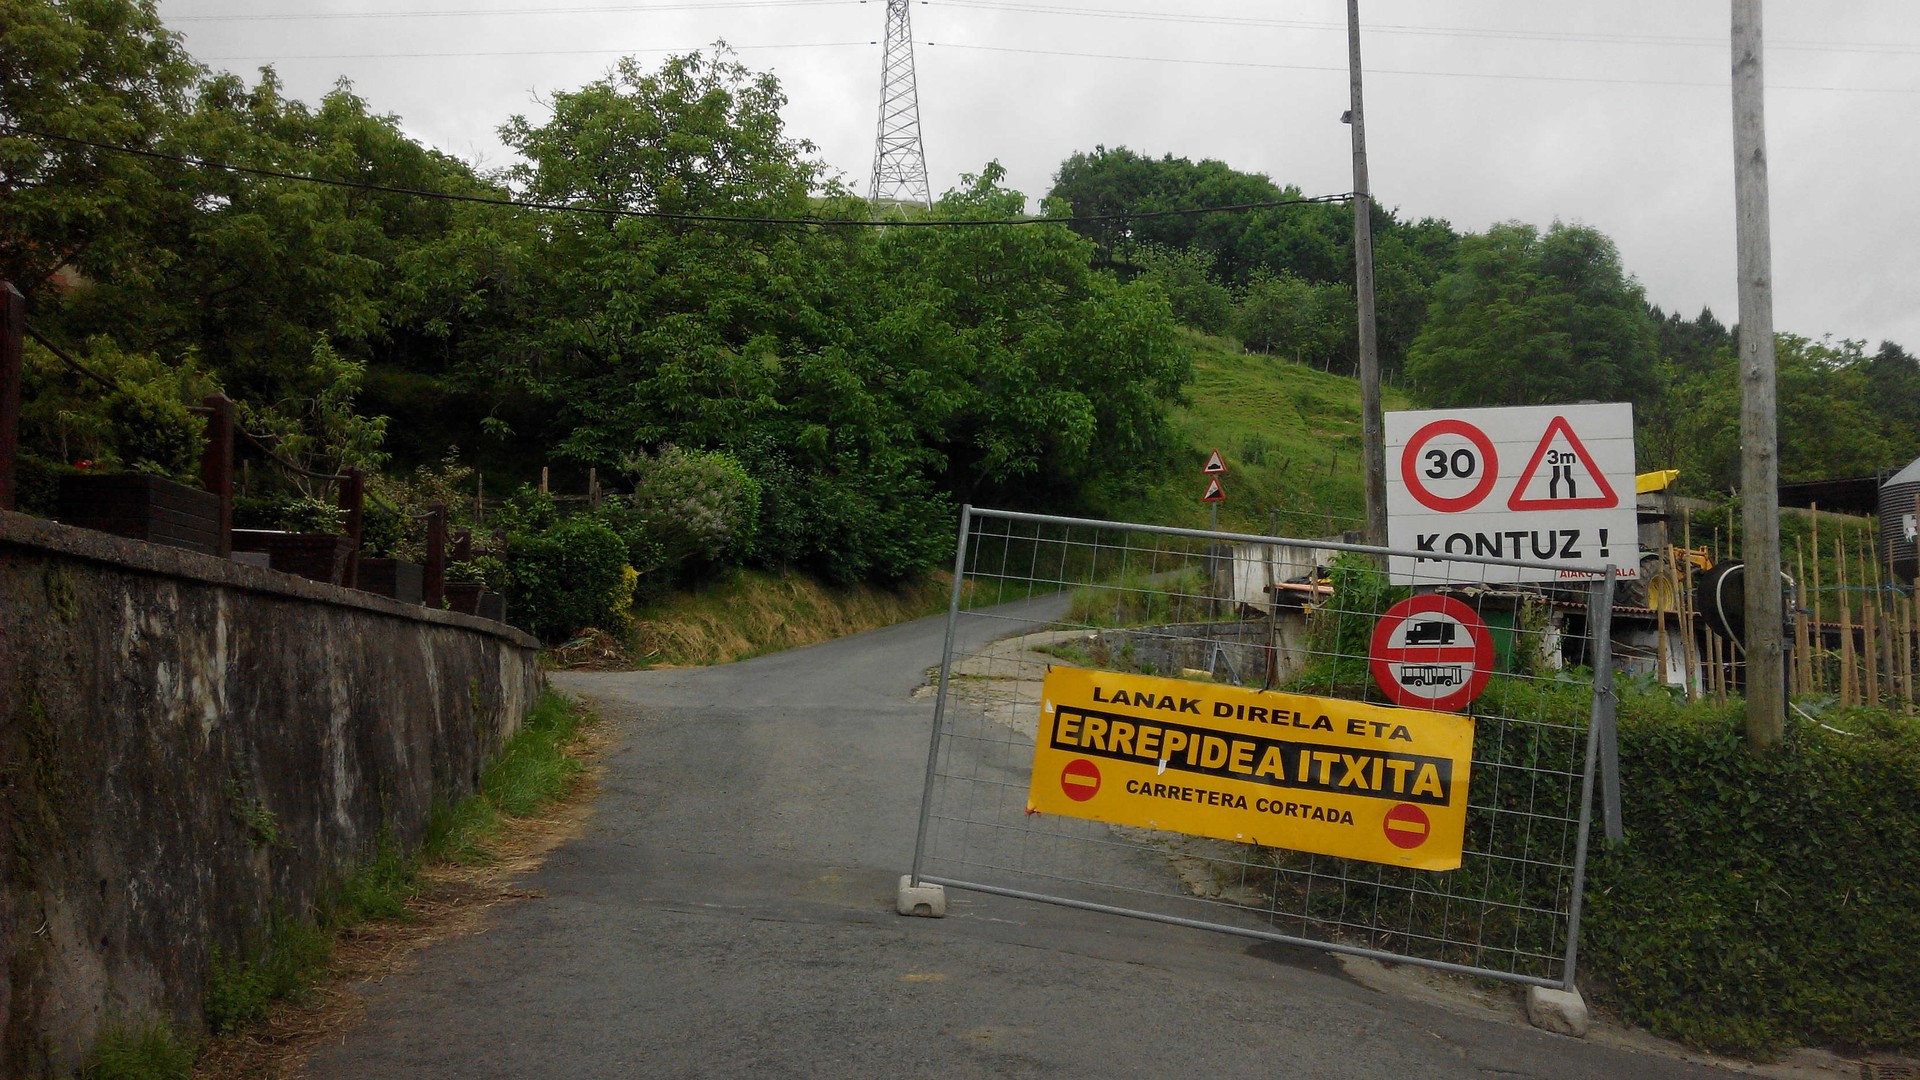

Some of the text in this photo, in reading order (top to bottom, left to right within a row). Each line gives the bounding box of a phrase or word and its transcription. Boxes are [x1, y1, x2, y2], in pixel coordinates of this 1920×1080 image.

[1425, 449, 1476, 479] 30
[1547, 450, 1576, 465] 3m
[1416, 529, 1582, 563] KONTUZ
[1093, 686, 1413, 742] LANAK DIRELA ETA
[1056, 713, 1444, 799] ERREPIDEA ITXITA
[1126, 779, 1354, 826] CARRETERA CORTADA
